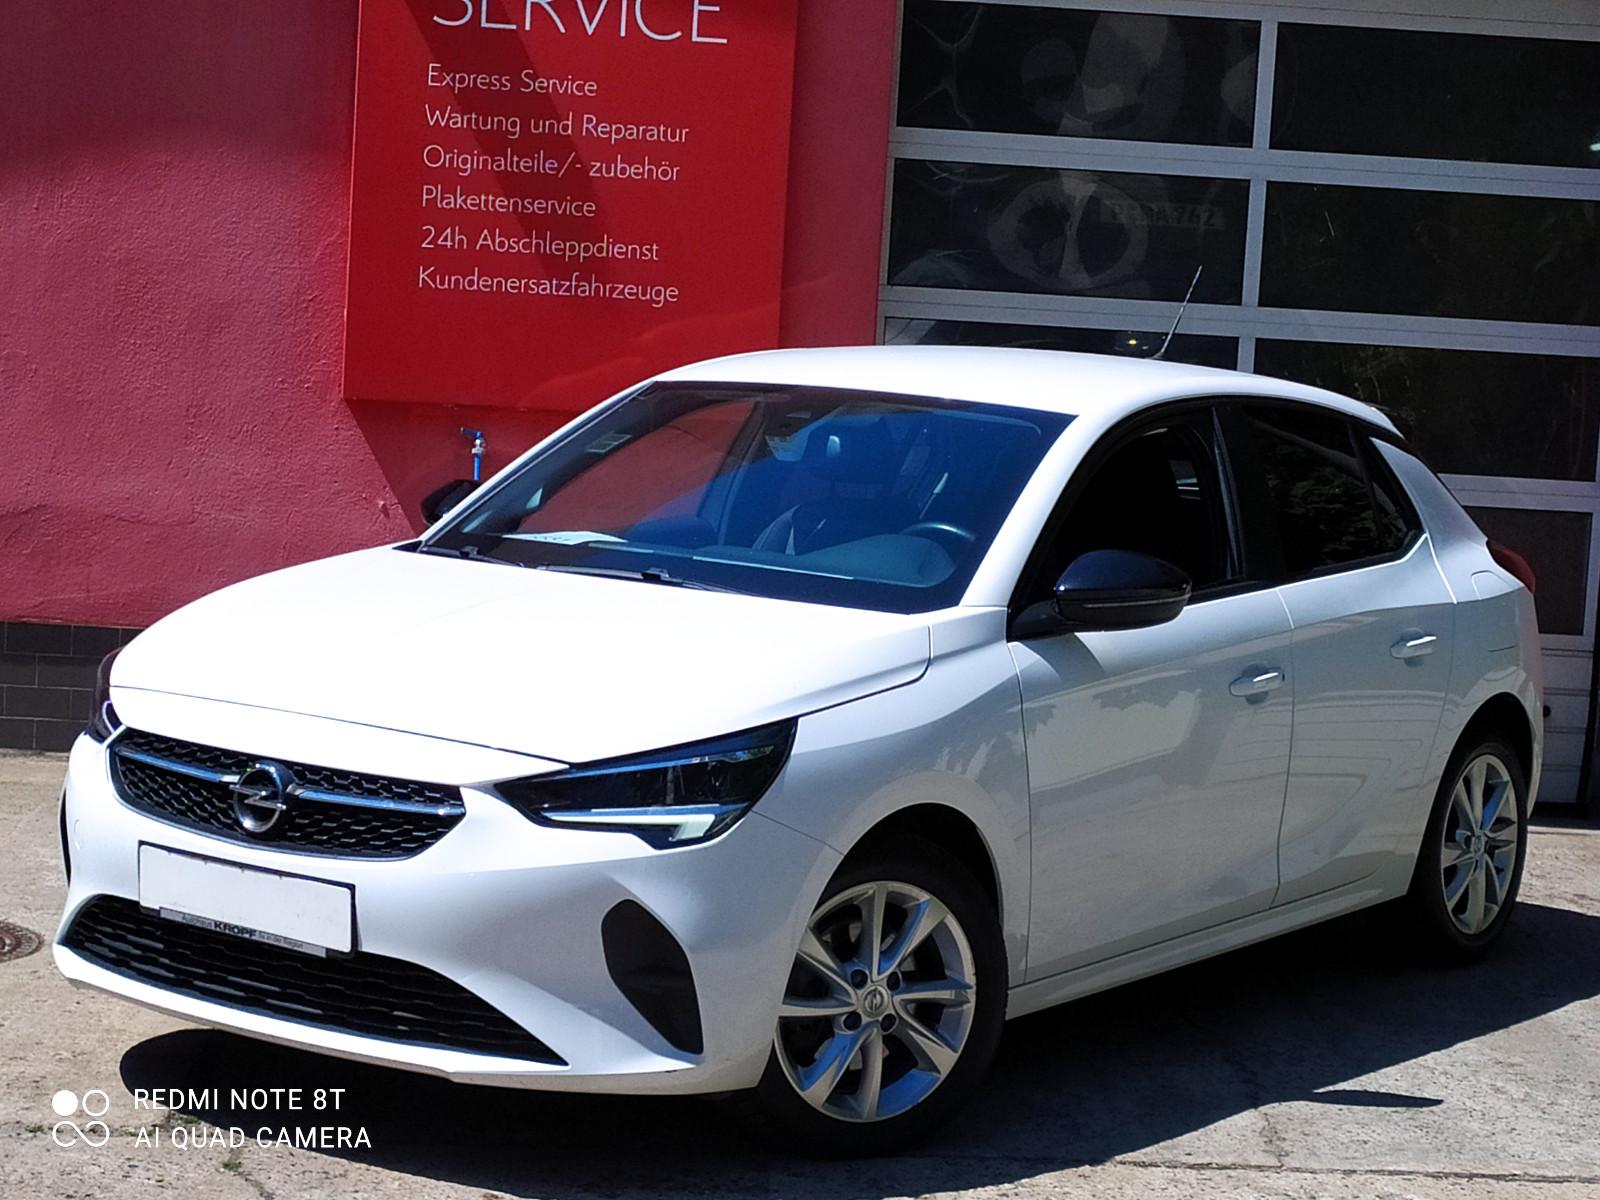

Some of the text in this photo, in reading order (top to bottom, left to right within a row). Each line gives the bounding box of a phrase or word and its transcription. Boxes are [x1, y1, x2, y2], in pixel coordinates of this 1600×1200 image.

[428, 63, 597, 96] Express Service
[425, 104, 689, 144] Wartung und Reparatur
[589, 154, 680, 181] zubehör
[423, 184, 595, 216] Plakettenservice
[422, 226, 659, 262] 24h Abschleppdienst
[419, 266, 678, 307] Kundenersatzfahrzeuge
[214, 920, 257, 937] KROPF
